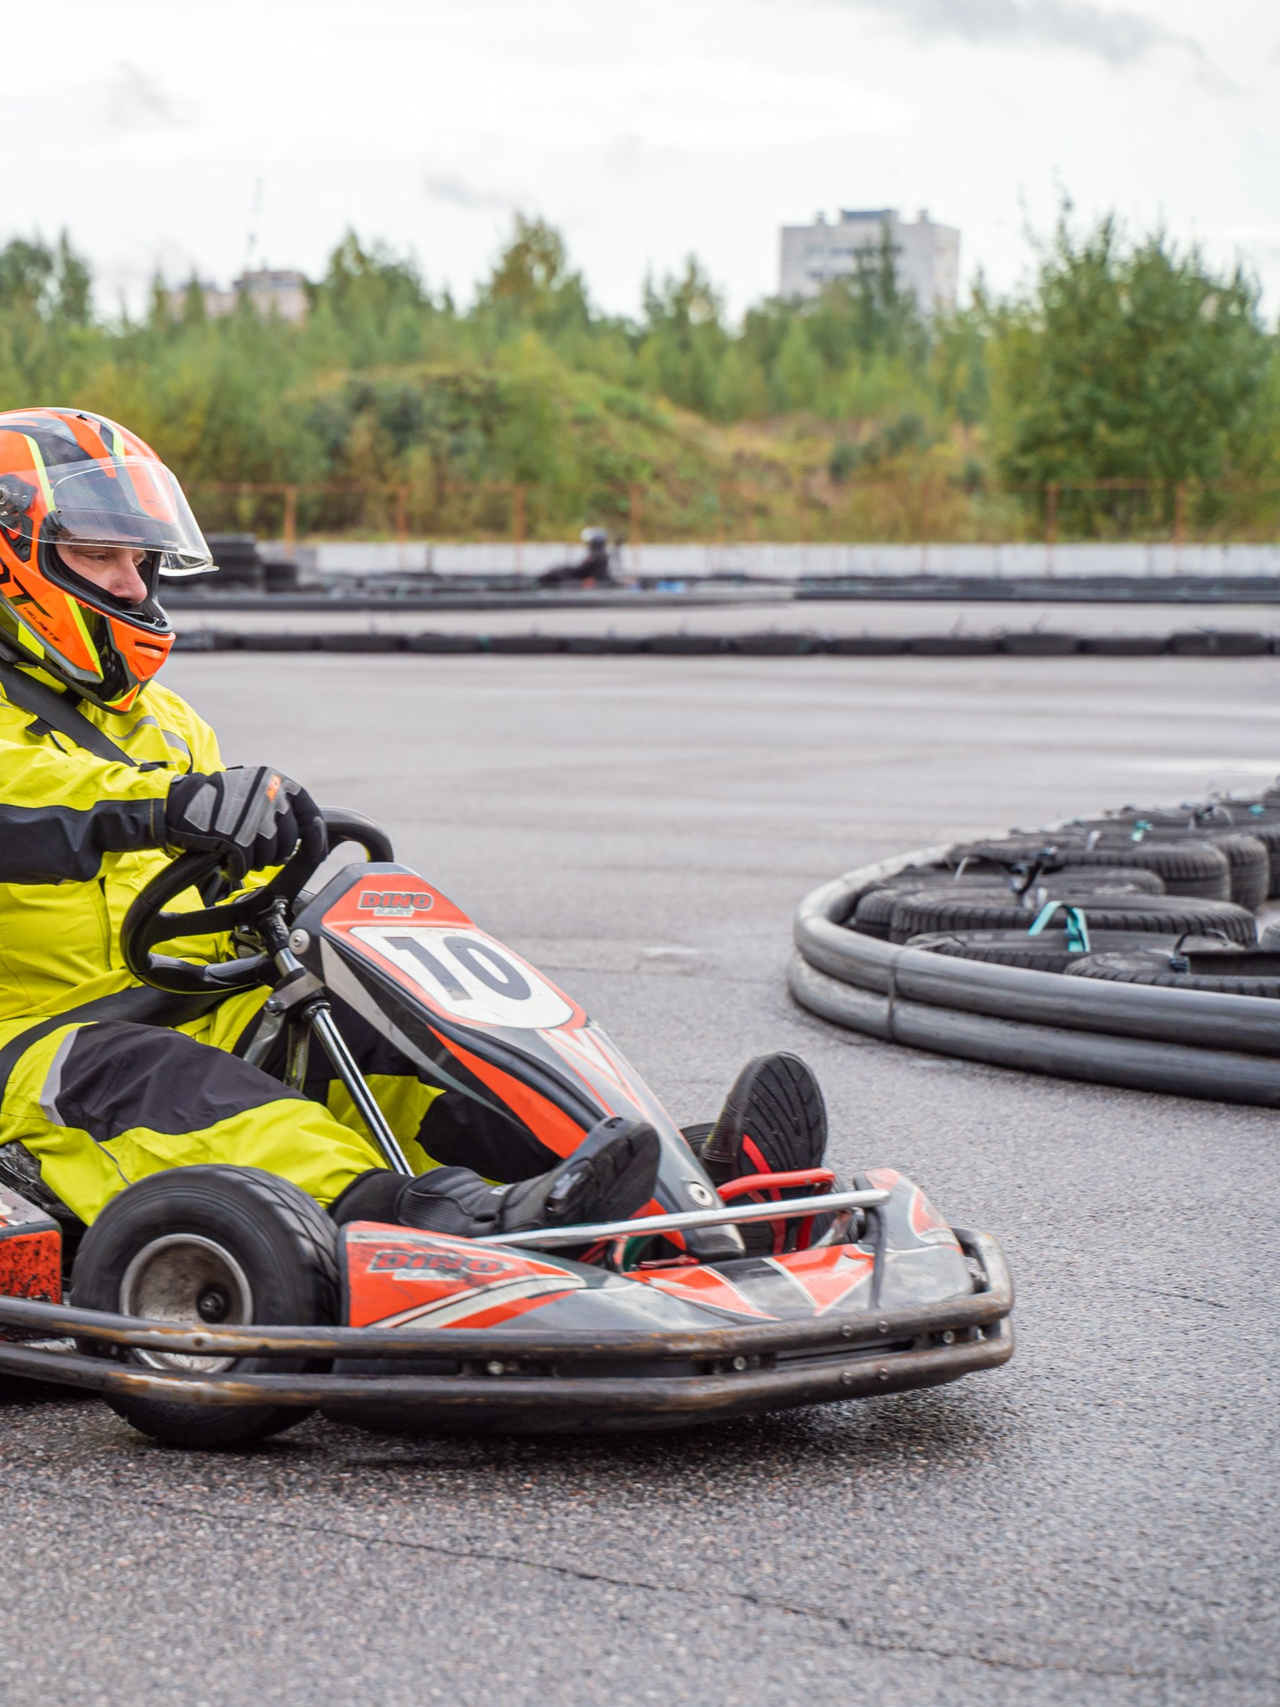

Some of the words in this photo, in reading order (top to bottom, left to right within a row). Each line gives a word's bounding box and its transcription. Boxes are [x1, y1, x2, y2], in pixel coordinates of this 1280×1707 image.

[23, 606, 63, 643] HELMETS
[358, 891, 434, 911] DINO
[384, 935, 532, 1001] 10
[369, 1251, 505, 1273] DINO
